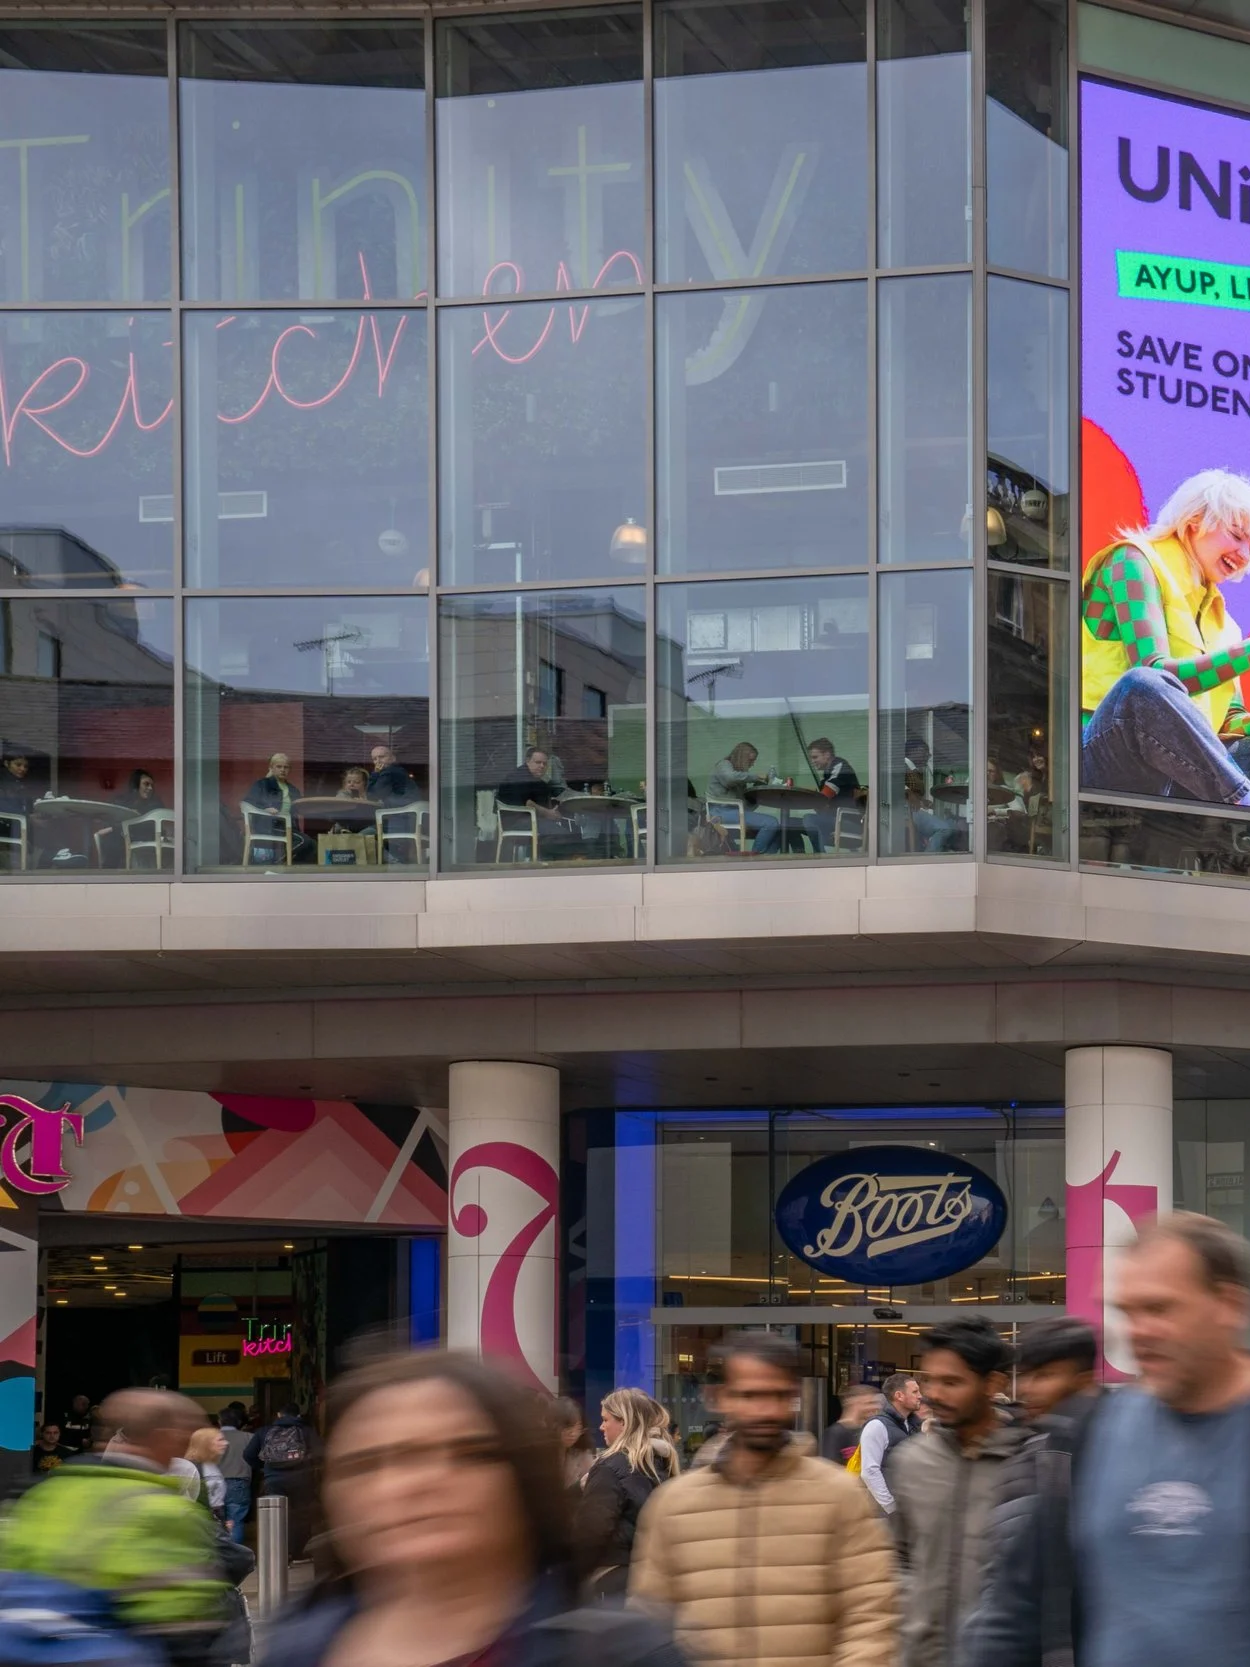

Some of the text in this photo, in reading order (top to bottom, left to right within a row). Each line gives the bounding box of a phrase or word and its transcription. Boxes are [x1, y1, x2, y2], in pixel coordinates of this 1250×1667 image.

[1134, 263, 1222, 300] AYUP,
[0, 250, 690, 468] kichen
[1116, 329, 1203, 372] SAVE
[803, 1172, 973, 1259] Boots
[205, 1352, 227, 1364] Lift
